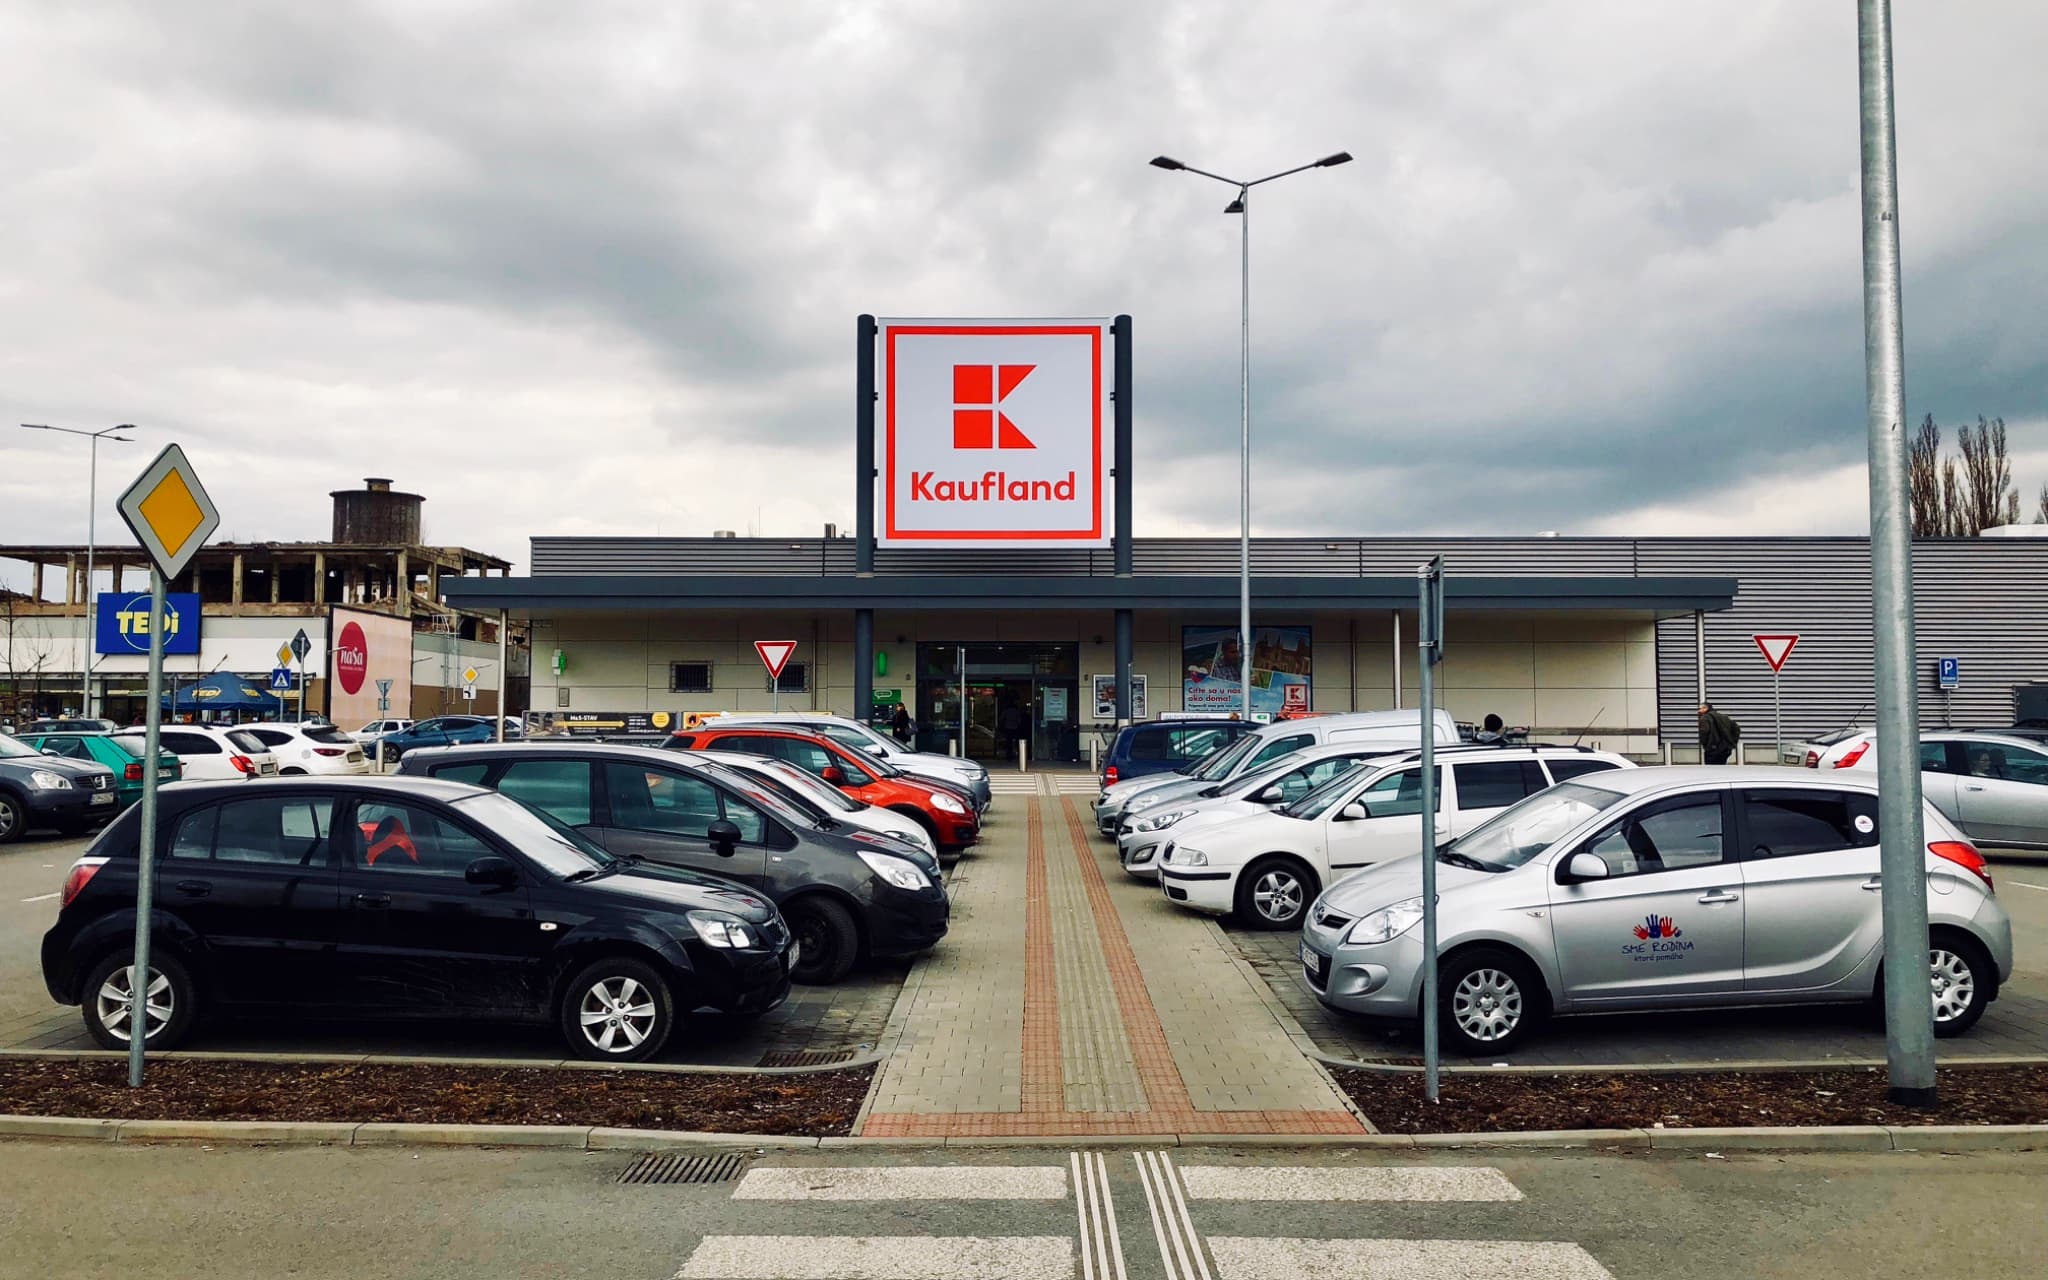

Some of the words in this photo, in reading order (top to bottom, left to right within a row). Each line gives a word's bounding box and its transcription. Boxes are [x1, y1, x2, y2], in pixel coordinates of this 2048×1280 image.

[953, 364, 1037, 449] K
[911, 471, 1075, 501] Kaufland
[1944, 660, 1953, 675] P
[1290, 688, 1300, 699] K
[1622, 943, 1647, 954] SME
